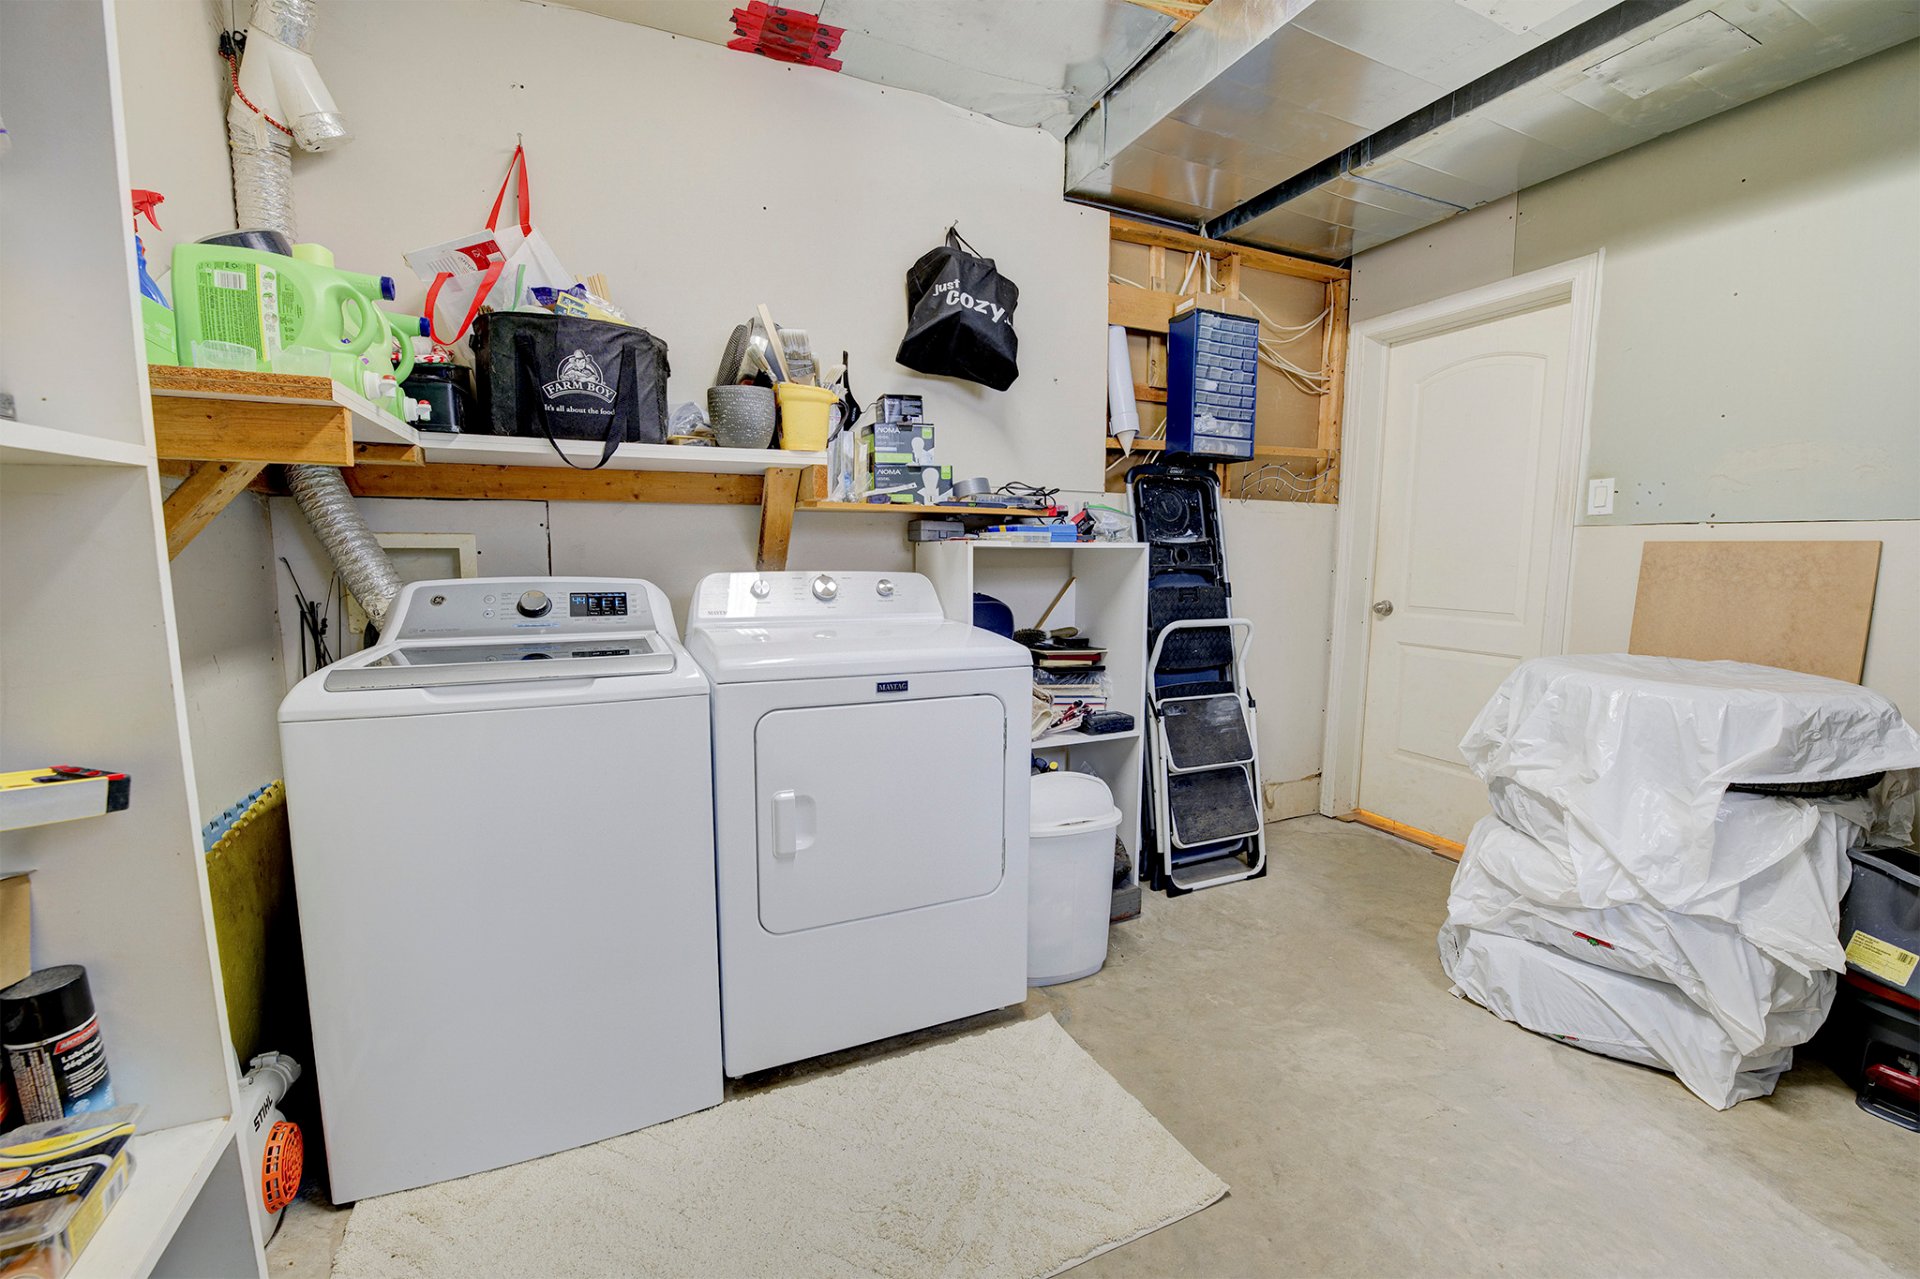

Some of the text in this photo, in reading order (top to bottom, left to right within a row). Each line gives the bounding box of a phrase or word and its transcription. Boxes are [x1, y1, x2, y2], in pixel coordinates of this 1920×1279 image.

[932, 279, 960, 297] just
[546, 380, 613, 398] FARM BOY
[544, 403, 555, 412] It's
[556, 404, 565, 412] all
[566, 405, 587, 413] about
[588, 407, 599, 415] the
[878, 682, 908, 692] MAYTAG
[253, 1094, 274, 1133] STIHL
